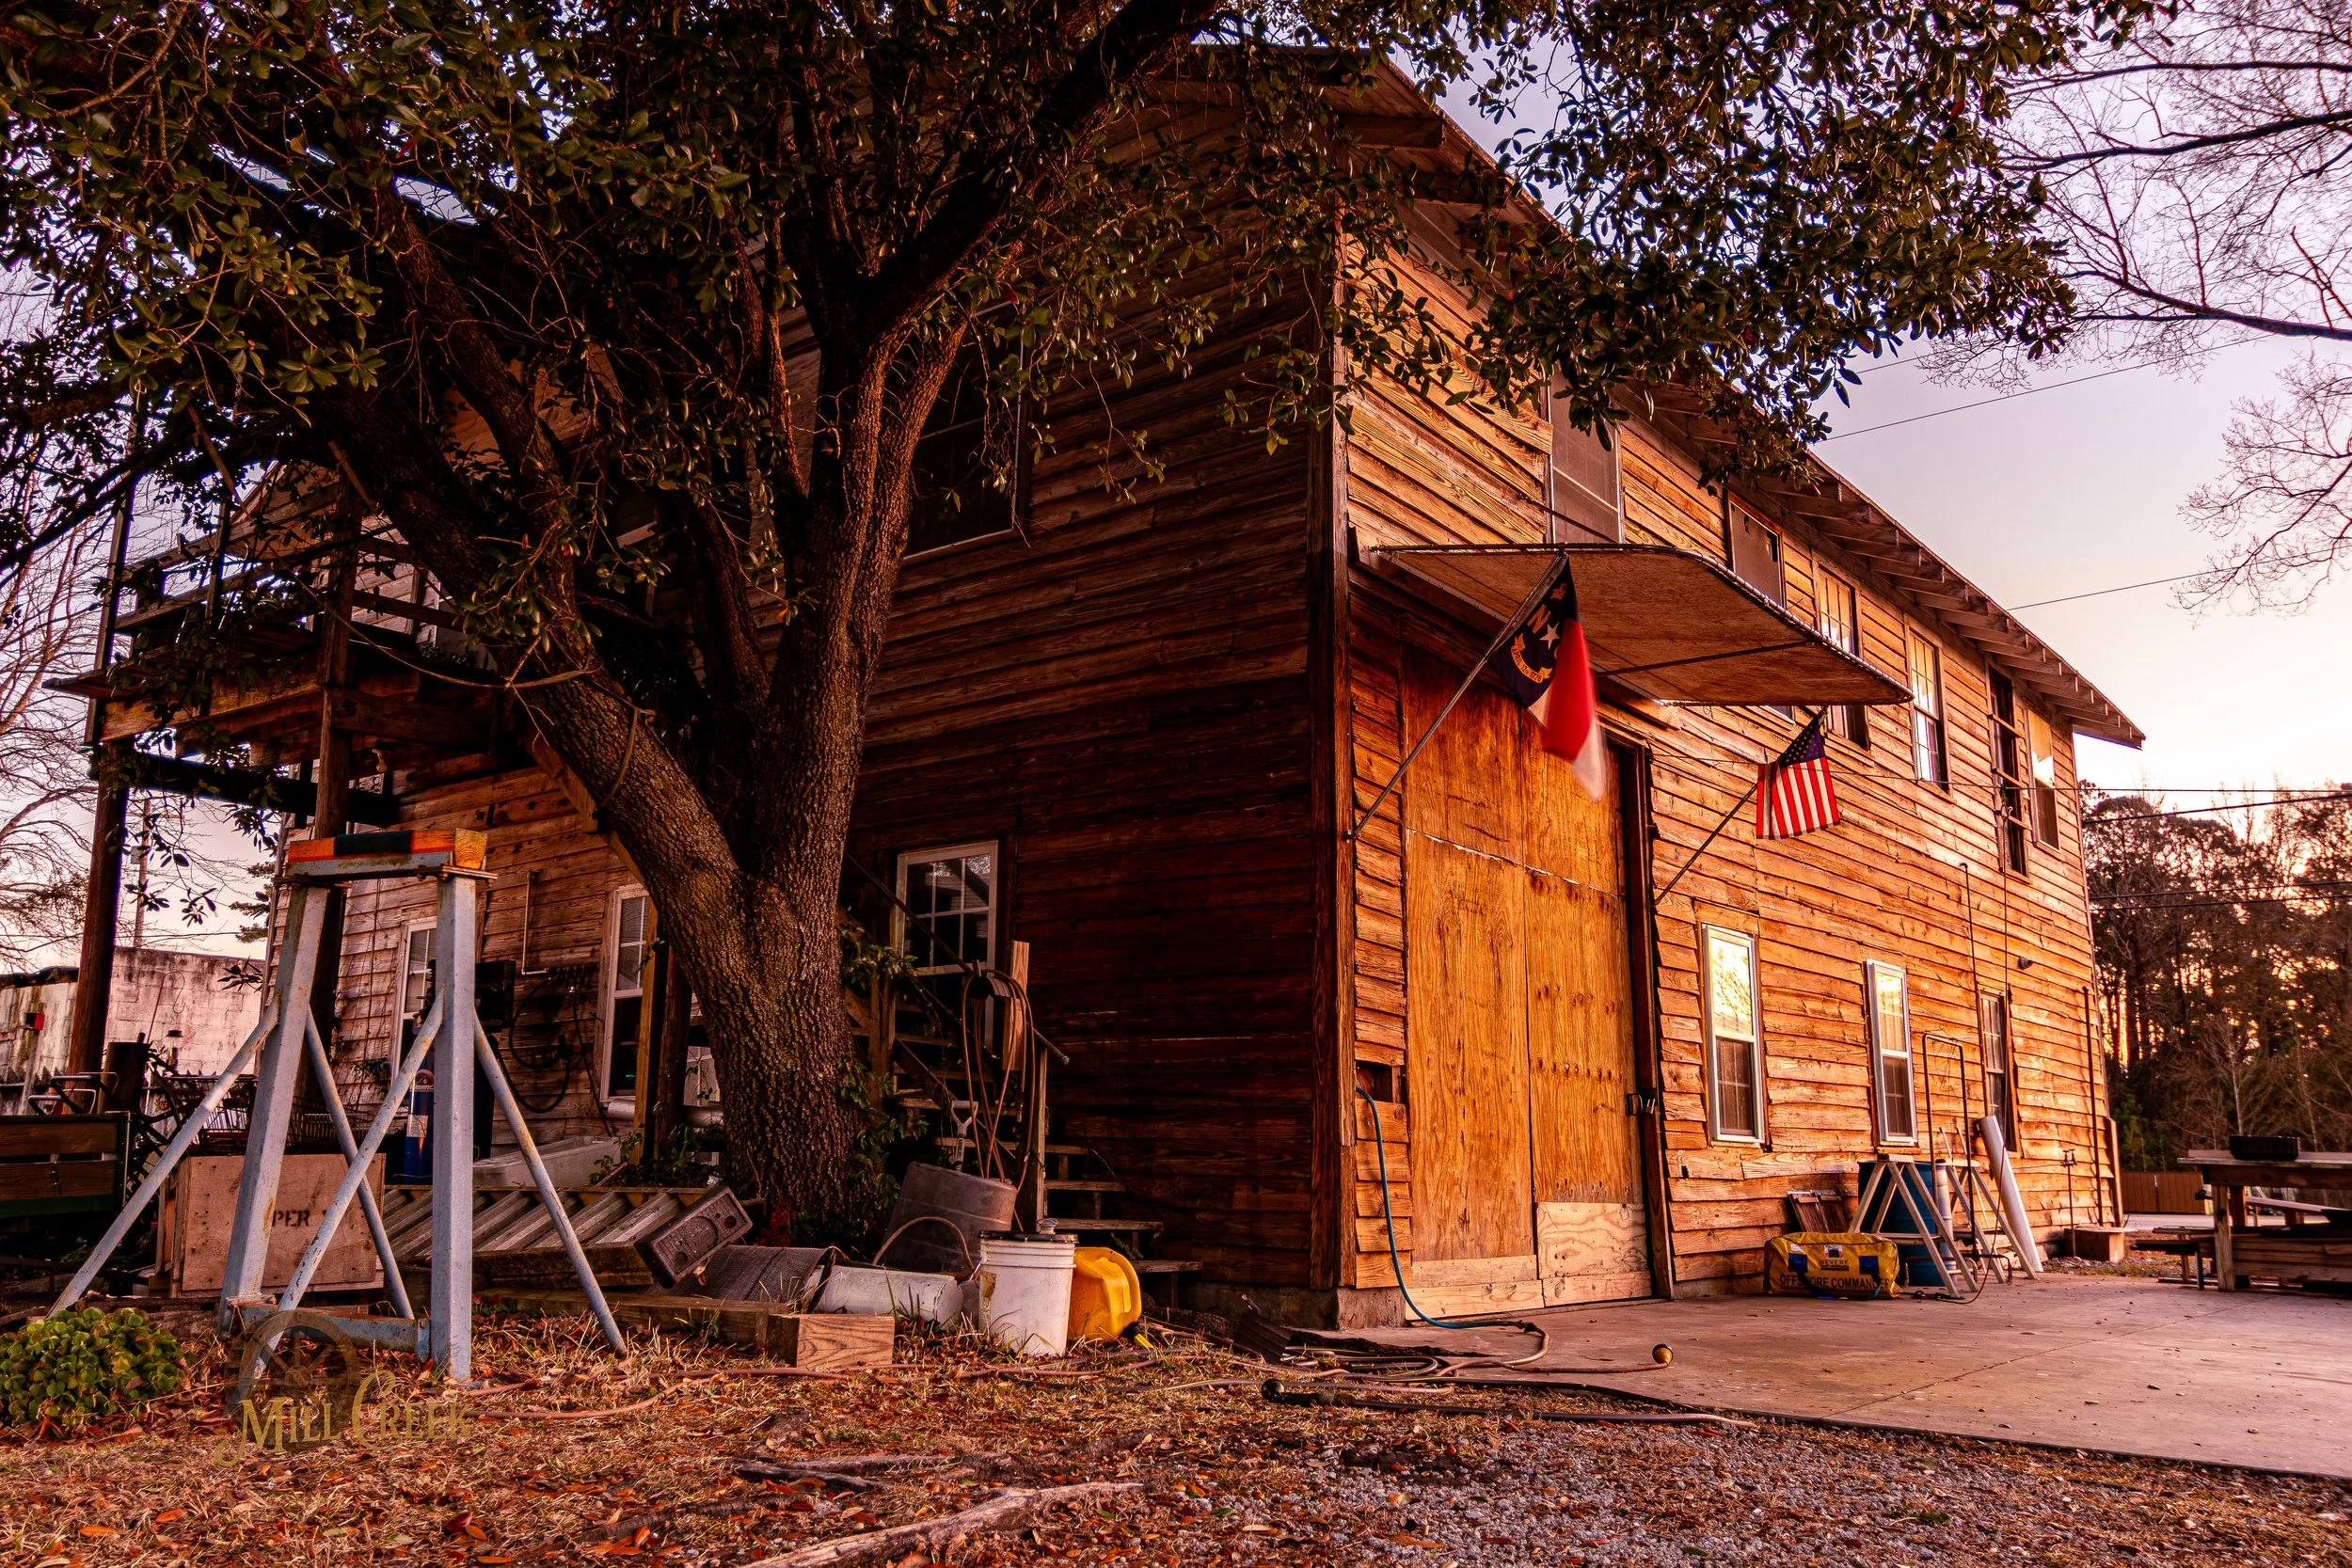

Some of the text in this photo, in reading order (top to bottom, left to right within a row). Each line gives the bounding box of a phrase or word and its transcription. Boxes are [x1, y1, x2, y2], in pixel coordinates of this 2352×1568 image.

[1527, 603, 1551, 634] N
[1511, 647, 1523, 665] APRIL
[1779, 1274, 1829, 1289] OFFSORE
